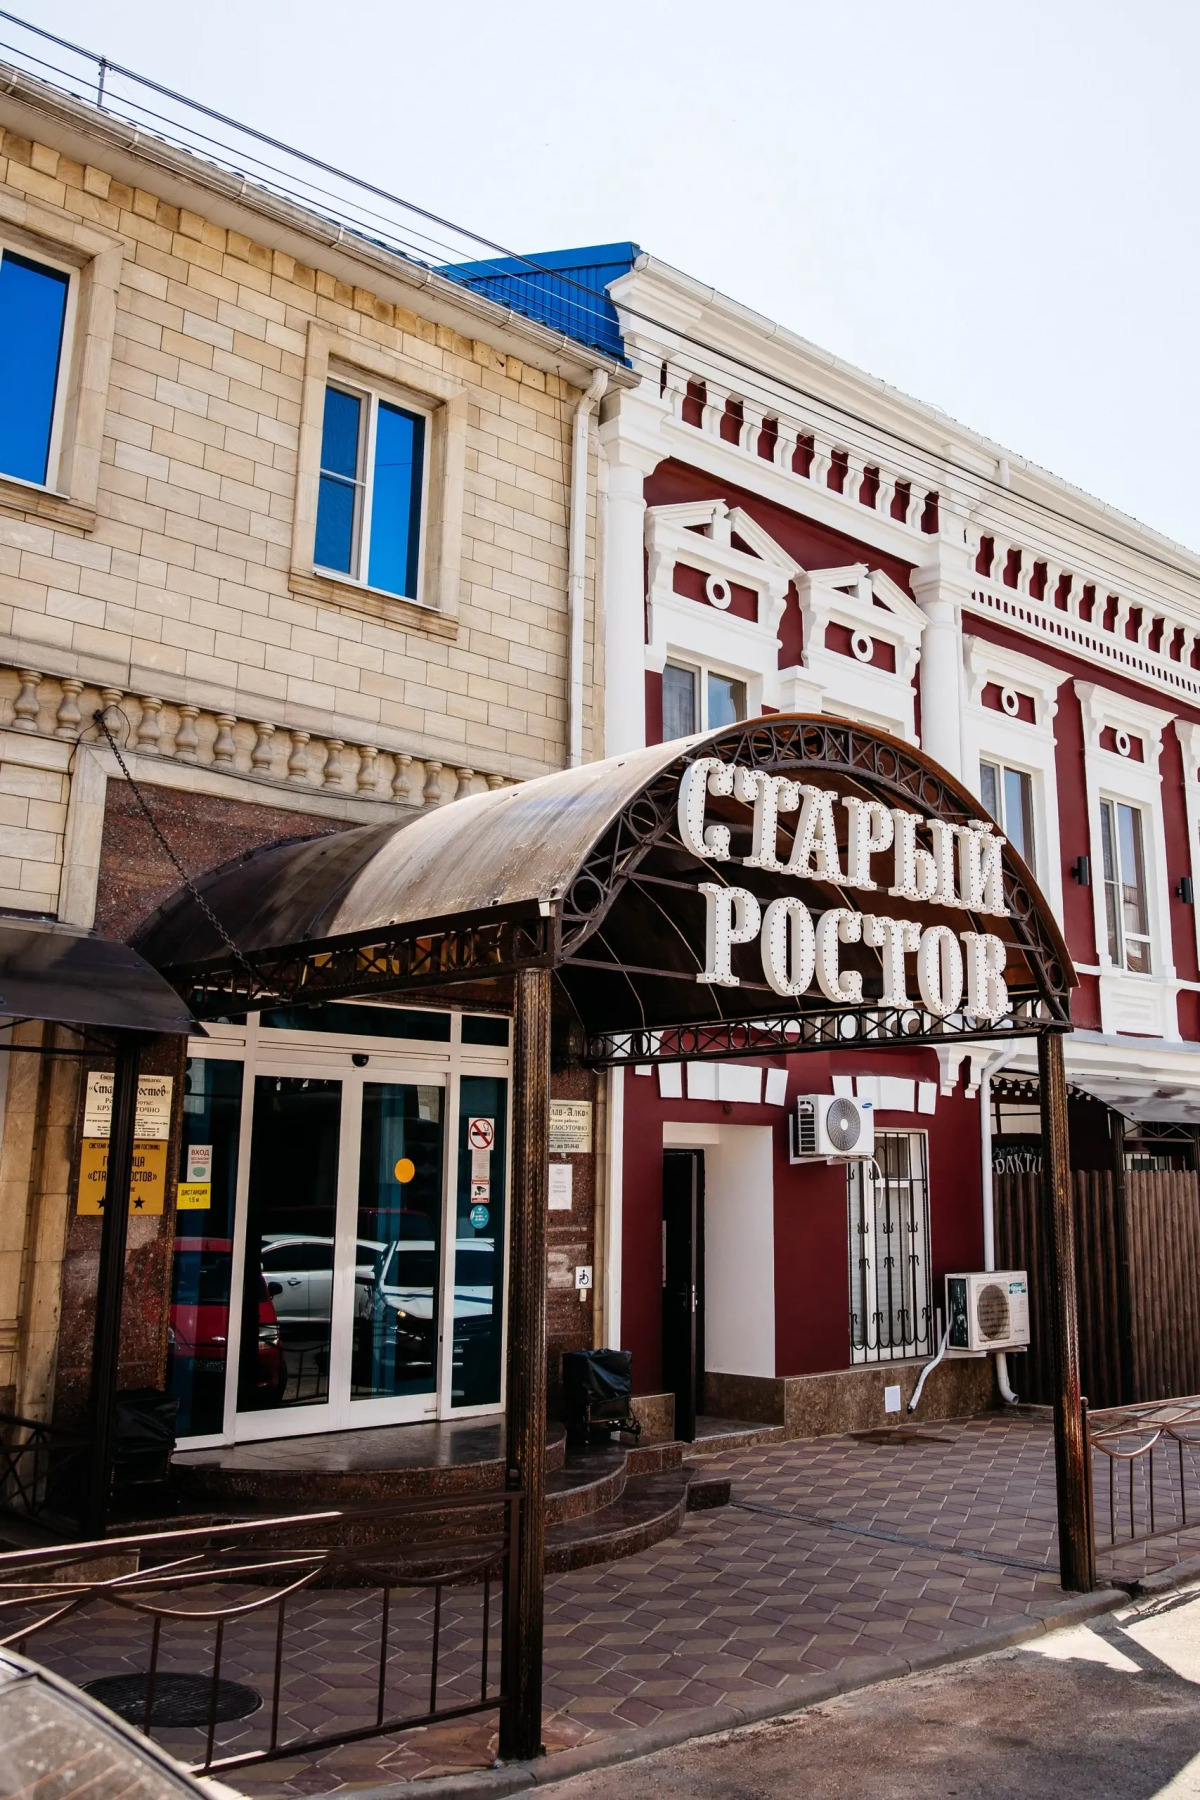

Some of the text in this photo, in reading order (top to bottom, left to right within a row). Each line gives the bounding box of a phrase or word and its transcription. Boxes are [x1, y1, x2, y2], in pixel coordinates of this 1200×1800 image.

[677, 757, 1011, 918] СТАРЫЙ
[696, 882, 1013, 1019] РОСТОВ
[138, 1085, 170, 1097] остов»
